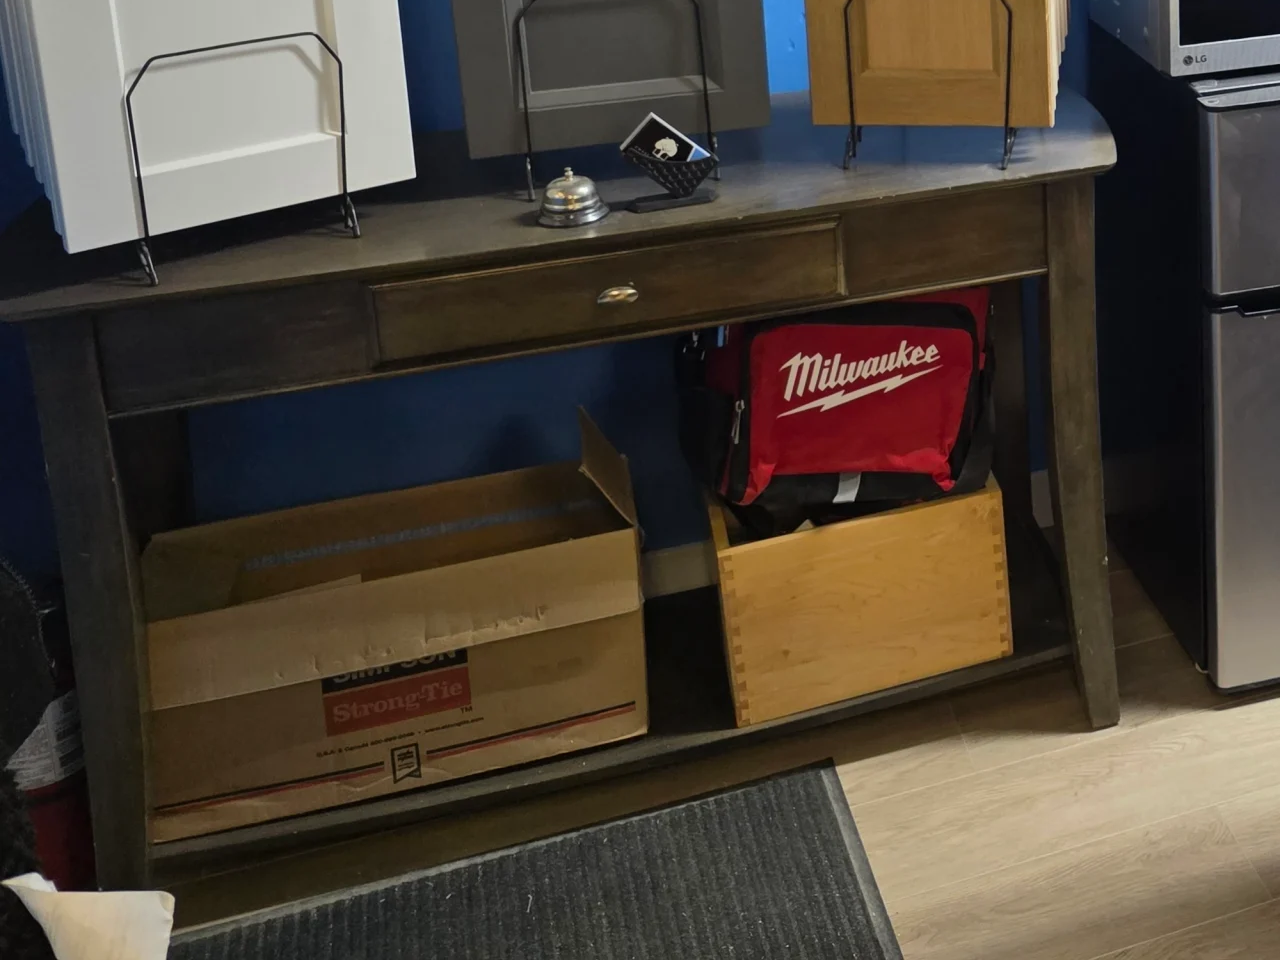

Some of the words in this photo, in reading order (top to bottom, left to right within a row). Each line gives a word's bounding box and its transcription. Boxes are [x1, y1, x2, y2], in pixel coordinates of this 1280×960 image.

[1195, 54, 1207, 64] LG
[778, 339, 941, 402] Milwaukee
[333, 680, 463, 723] Strong-Tie
[460, 705, 473, 715] TM
